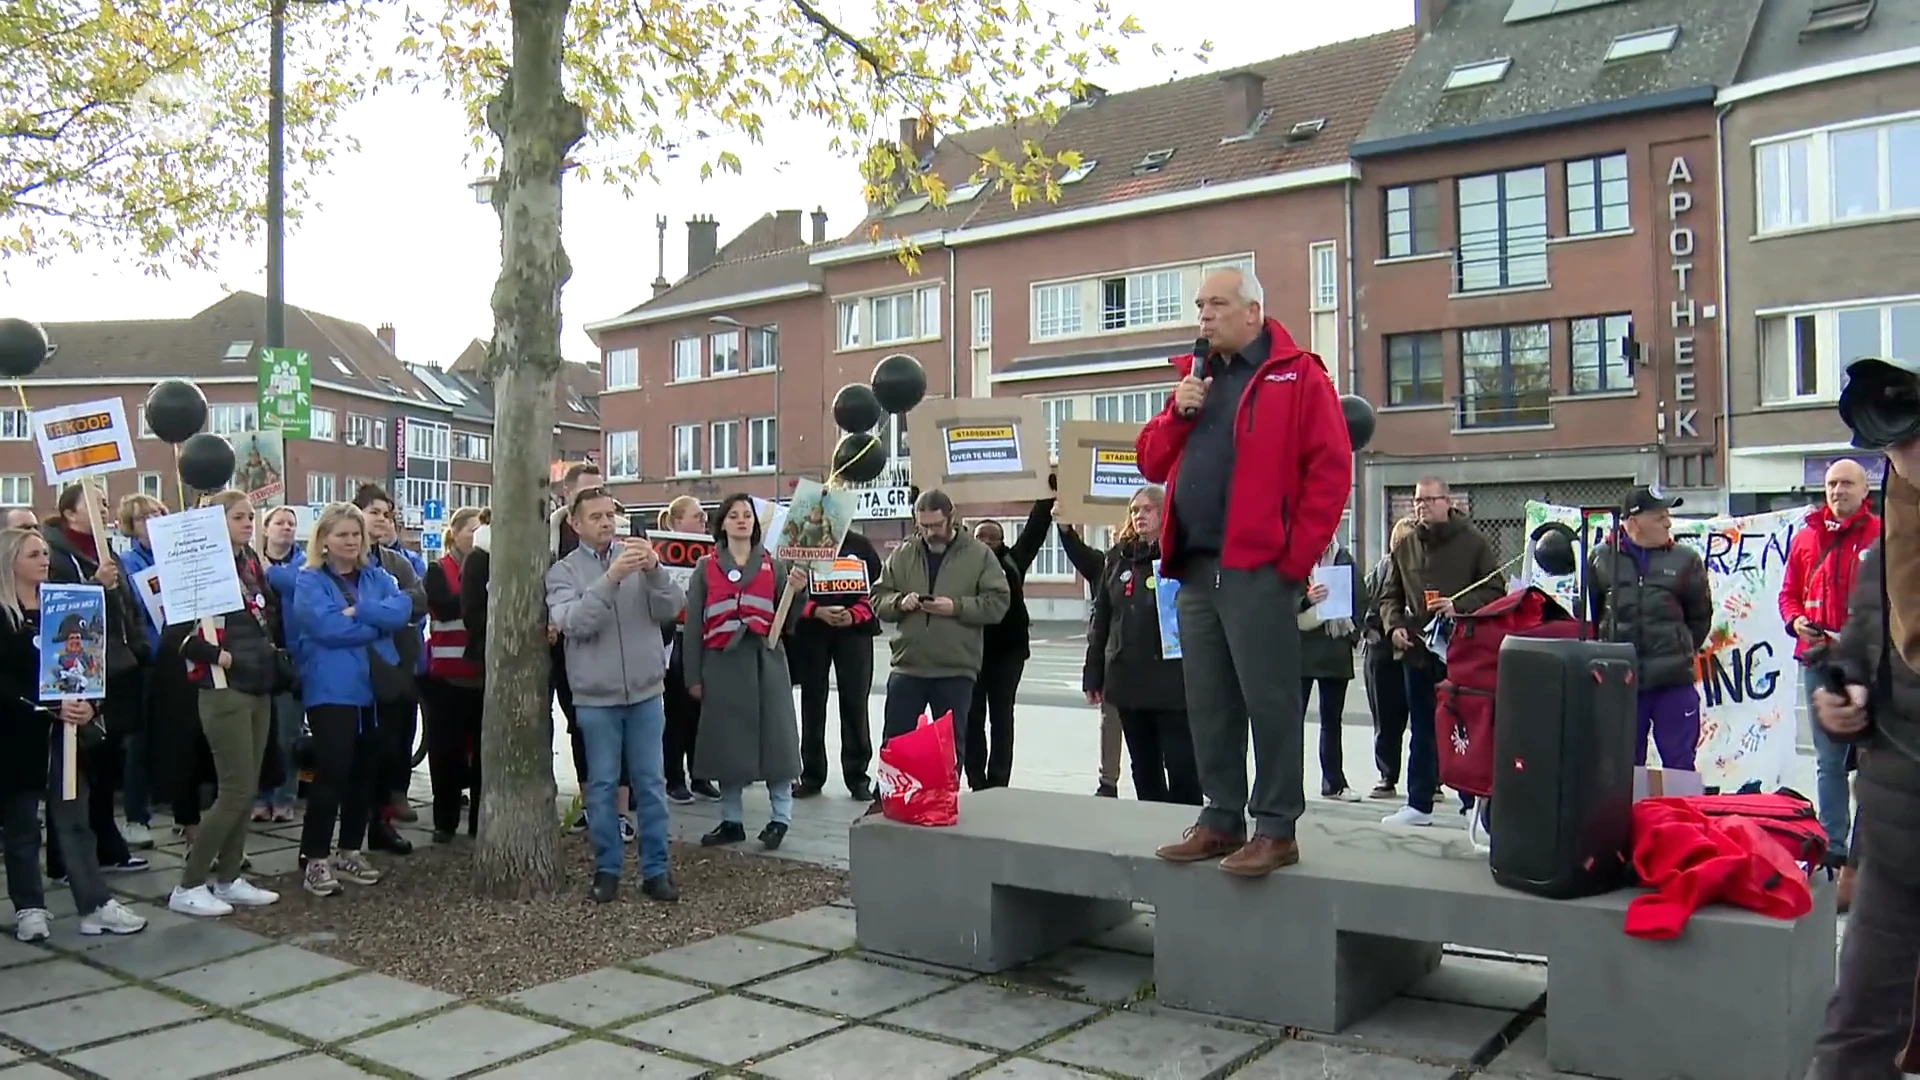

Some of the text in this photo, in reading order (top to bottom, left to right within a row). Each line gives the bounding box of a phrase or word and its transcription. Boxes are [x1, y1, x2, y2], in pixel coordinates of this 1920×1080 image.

[1667, 157, 1699, 438] APOTHEEK
[66, 415, 110, 434] KOOP
[814, 580, 865, 592] TE KOOP
